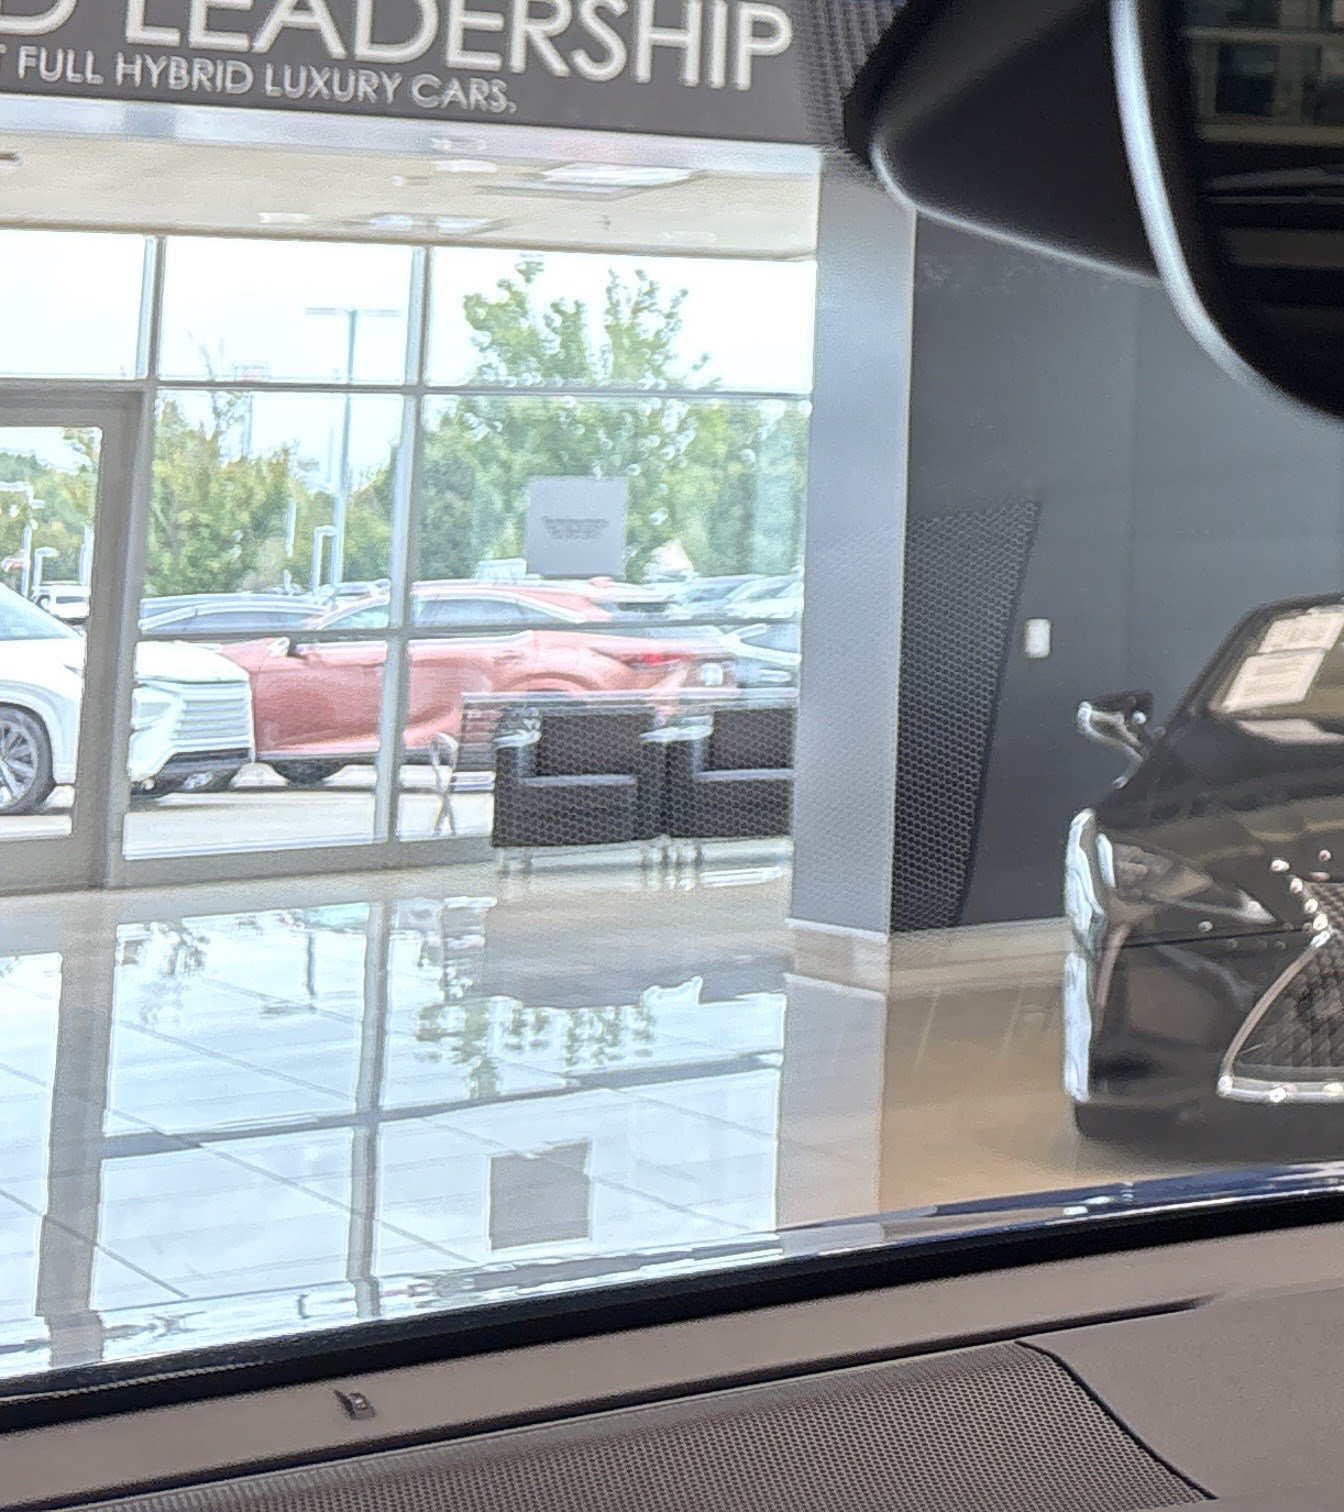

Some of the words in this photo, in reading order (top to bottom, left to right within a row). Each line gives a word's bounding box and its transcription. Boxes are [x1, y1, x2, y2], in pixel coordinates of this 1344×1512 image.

[17, 45, 104, 85] FULL
[115, 51, 254, 94] HYBRID
[264, 63, 402, 105] LUXURY
